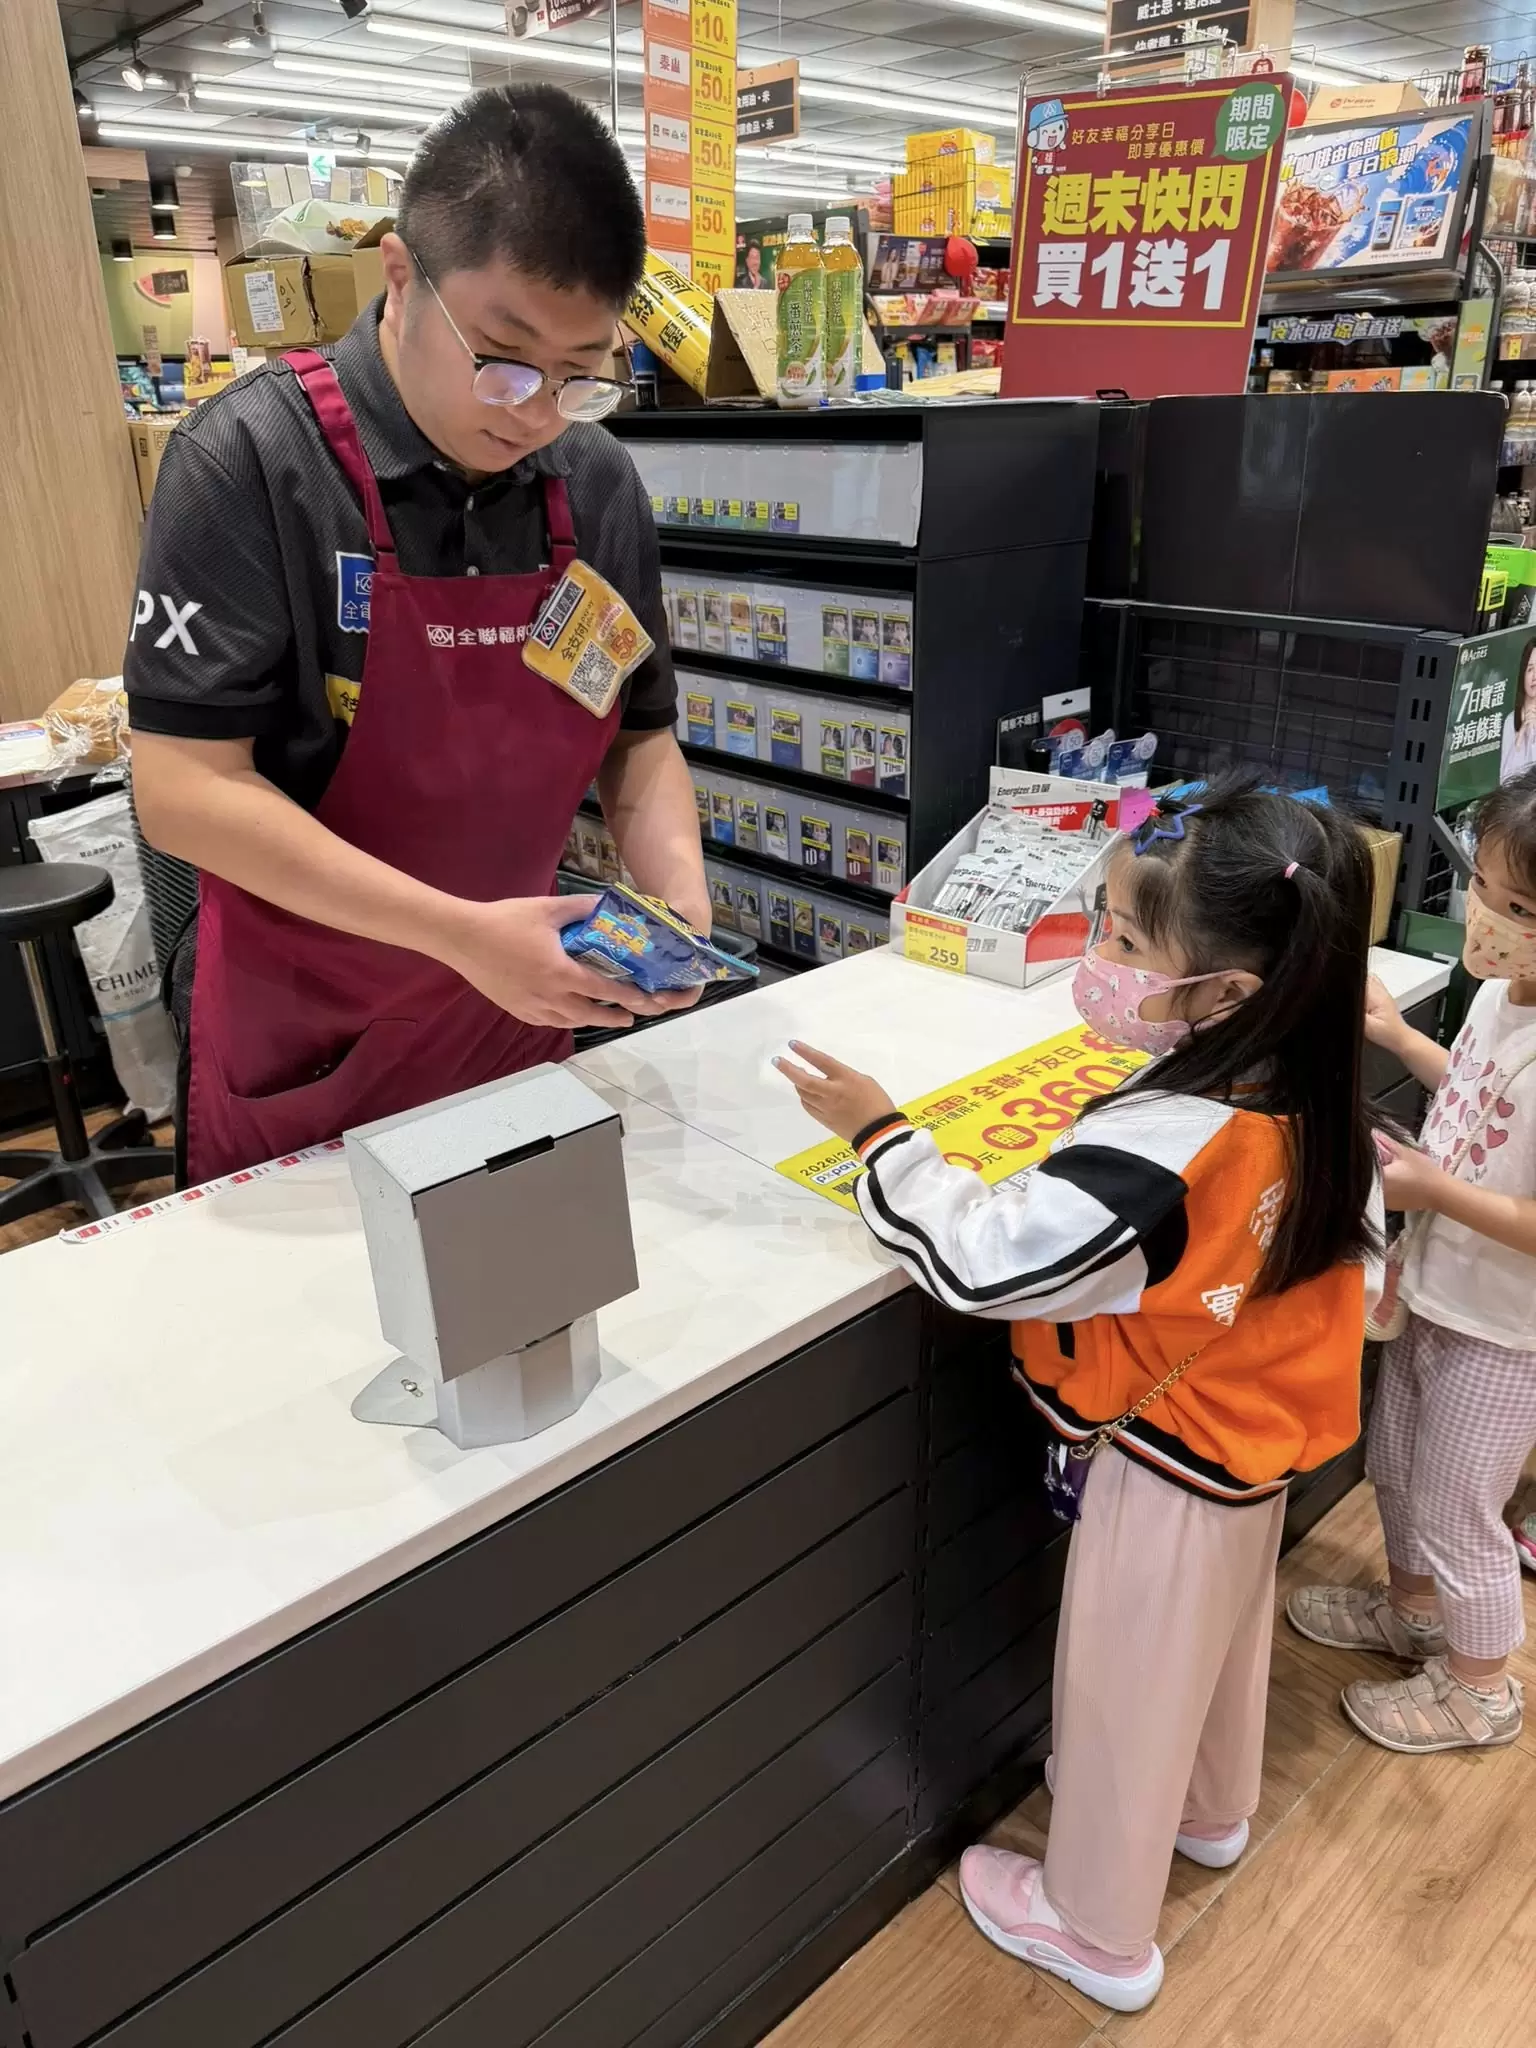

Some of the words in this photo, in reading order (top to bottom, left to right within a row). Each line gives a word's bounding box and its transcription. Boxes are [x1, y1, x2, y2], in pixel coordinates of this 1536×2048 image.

[701, 12, 724, 44] 10
[701, 74, 723, 102] 50
[1229, 94, 1275, 122] 期間
[1071, 122, 1176, 146] 好友幸福分享日
[1225, 124, 1270, 152] 限定
[701, 139, 723, 169] 50
[1127, 139, 1206, 160] 即享優惠價
[1041, 164, 1248, 237] 週末快閃
[701, 207, 723, 235] 50
[1032, 239, 1229, 310] 買1送1
[130, 590, 203, 656] PX
[561, 622, 588, 662] 全支付
[610, 628, 637, 659] 50
[929, 945, 961, 968] 259
[969, 1044, 1086, 1103] 全聯卡友日
[987, 1126, 1033, 1149] 贈
[980, 1149, 1003, 1166] 元
